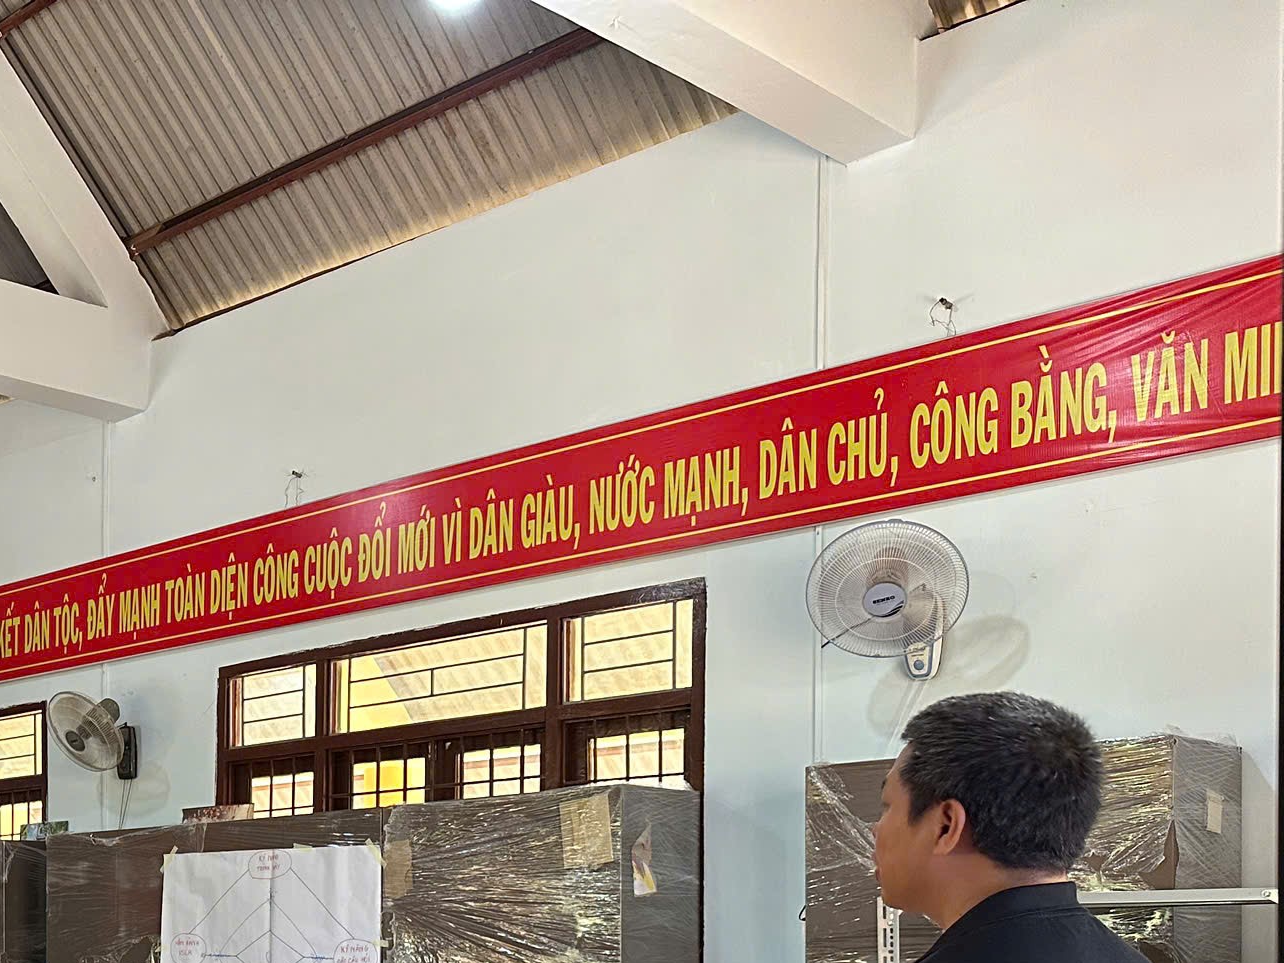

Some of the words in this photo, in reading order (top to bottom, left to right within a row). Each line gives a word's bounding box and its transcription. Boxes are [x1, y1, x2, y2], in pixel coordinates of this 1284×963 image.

[24, 601, 50, 654] DÂN
[54, 594, 82, 654] TỘC,
[87, 573, 115, 640] ĐẨY
[119, 583, 160, 640] MẠNH
[165, 564, 205, 624] TOÀN
[210, 552, 249, 620] DIỆN
[253, 543, 299, 606] CÔNG
[304, 527, 352, 599] CUỘC
[357, 501, 391, 583] ĐỔI
[397, 504, 436, 574] MỚI
[442, 498, 462, 565] VÌ
[469, 488, 514, 559] DÂN
[521, 474, 580, 550] GIÀU,
[589, 454, 655, 534] NƯỚC
[664, 446, 749, 526] MẠNH,
[759, 417, 817, 499] DÂN
[827, 388, 899, 487] CHỦ,
[910, 381, 998, 469] CÔNG
[1010, 345, 1117, 444] BẰNG,
[1131, 331, 1208, 422] VĂN
